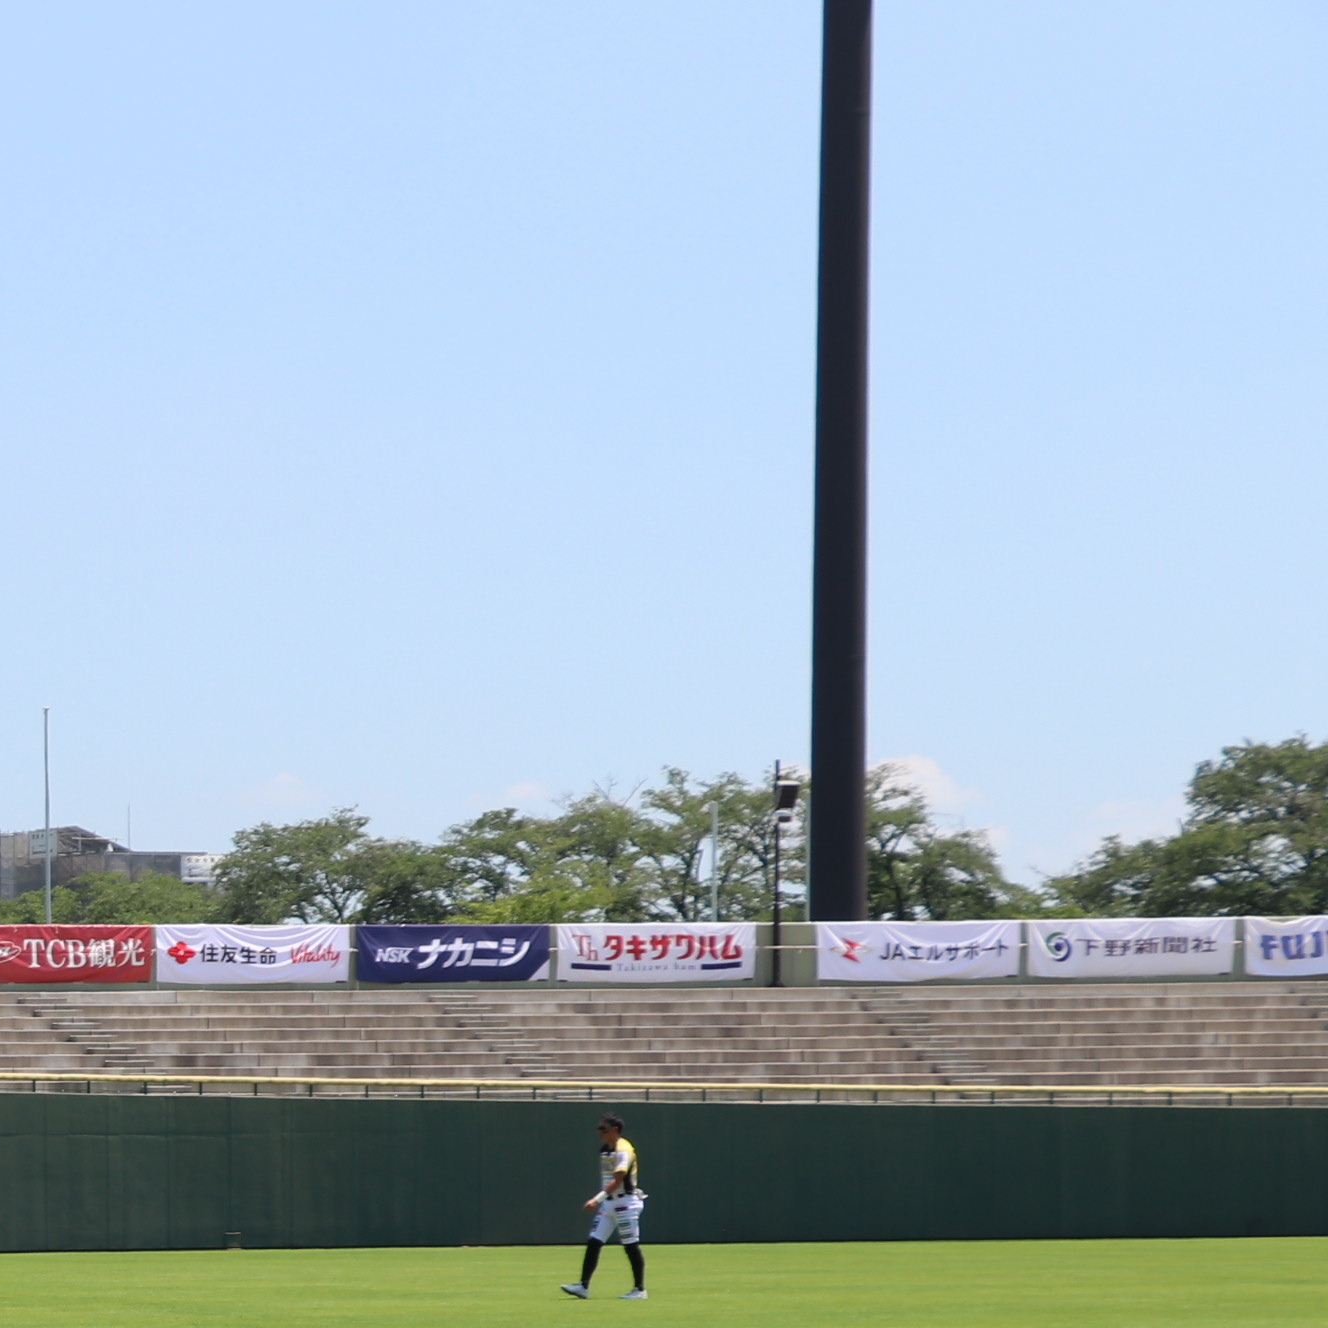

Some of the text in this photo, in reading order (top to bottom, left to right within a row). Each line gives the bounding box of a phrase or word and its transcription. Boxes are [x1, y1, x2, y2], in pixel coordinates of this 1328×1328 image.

[23, 938, 146, 968] TCB観光
[200, 942, 342, 968] 住友生命 Vitality
[375, 937, 531, 969] NSK ナカニシ
[603, 934, 744, 961] タキザワハム
[879, 939, 1009, 962] JAエルサポート
[1076, 936, 1218, 957] 下野新聞社
[1260, 930, 1328, 960] FUJ
[616, 963, 697, 972] Takizawa ham
